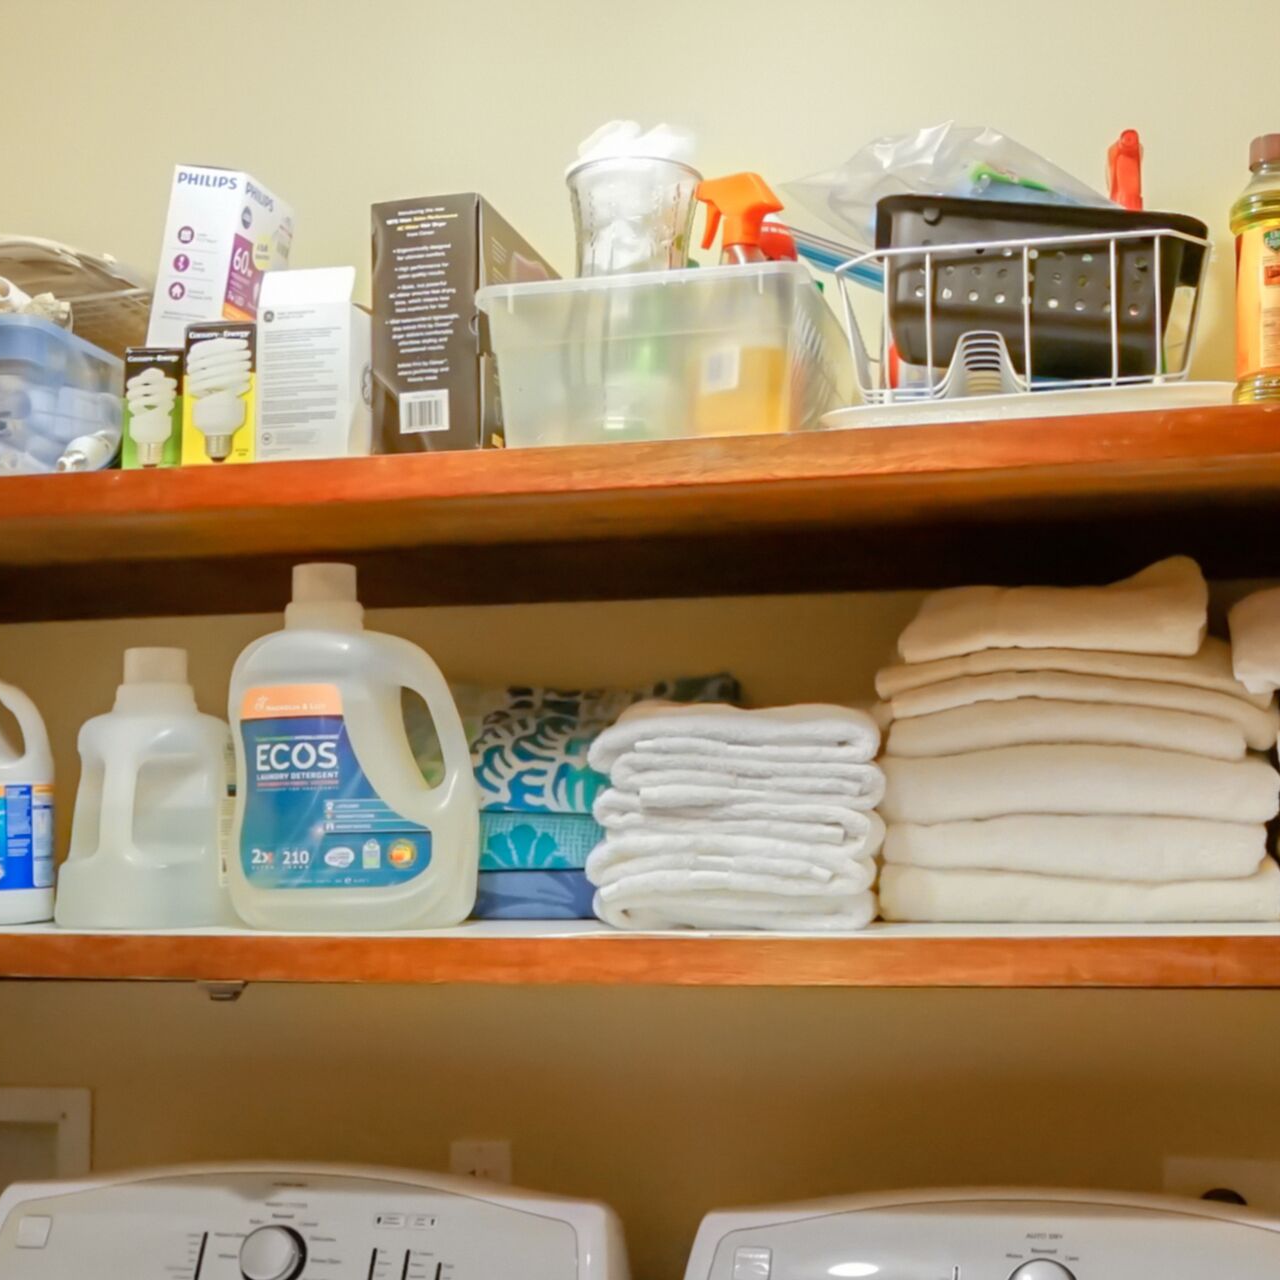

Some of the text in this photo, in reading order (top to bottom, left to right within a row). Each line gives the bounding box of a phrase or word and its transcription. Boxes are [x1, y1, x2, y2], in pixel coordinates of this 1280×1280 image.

[177, 172, 238, 190] PHILIPS
[245, 181, 274, 213] PHILIPS
[257, 742, 338, 771] ECOS
[291, 771, 338, 780] DETERGENT
[282, 850, 310, 864] 210
